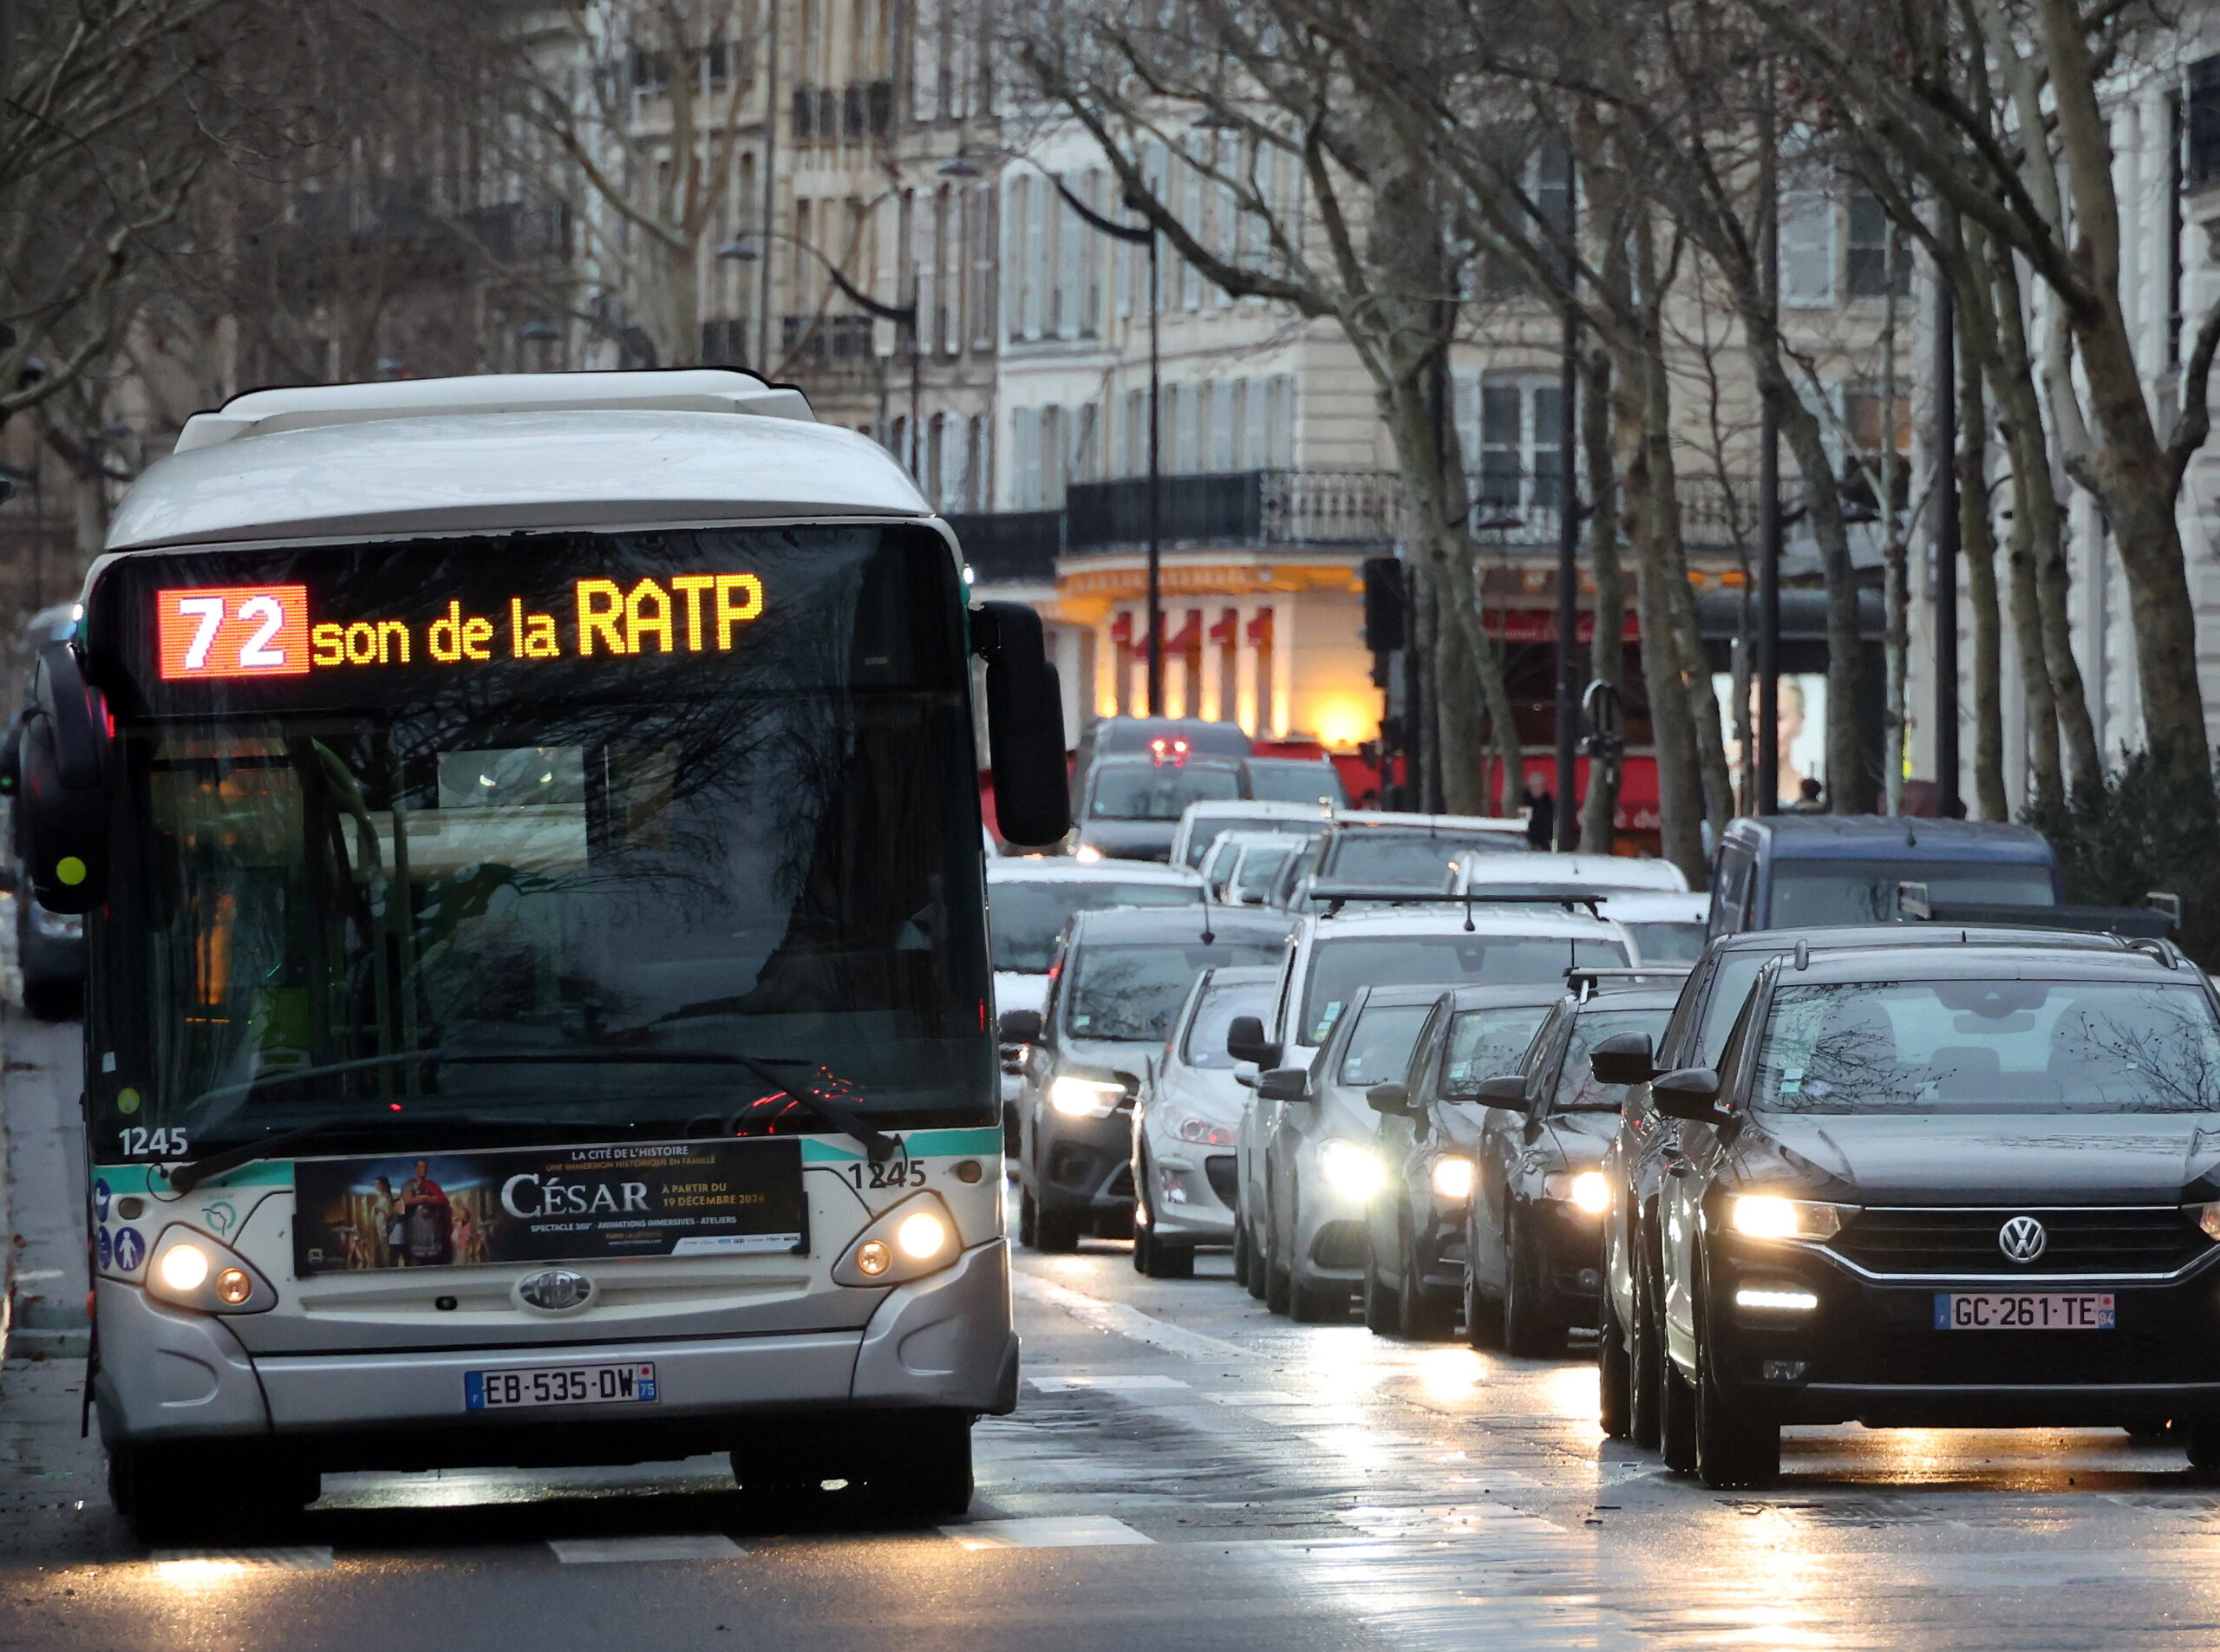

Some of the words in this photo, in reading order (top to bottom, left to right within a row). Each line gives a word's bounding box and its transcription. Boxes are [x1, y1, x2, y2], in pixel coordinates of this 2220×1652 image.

[312, 621, 410, 665] son
[429, 599, 493, 662] de
[512, 597, 559, 658] la
[577, 573, 762, 656] RATP
[180, 596, 284, 669] 72
[119, 1126, 188, 1155] 1245
[572, 1152, 586, 1160] LA
[590, 1147, 611, 1159] CITÉ
[615, 1148, 627, 1158] DE
[630, 1146, 689, 1158] L'HISTOIRE
[848, 1160, 926, 1189] 1245
[501, 1173, 651, 1218] CÉSAR
[672, 1183, 708, 1193] PARTIR
[711, 1182, 727, 1192] DU
[663, 1198, 676, 1206] 19
[531, 1223, 573, 1232] SPECTACLE
[701, 1216, 737, 1224] ATELIERS
[640, 1382, 654, 1396] 75
